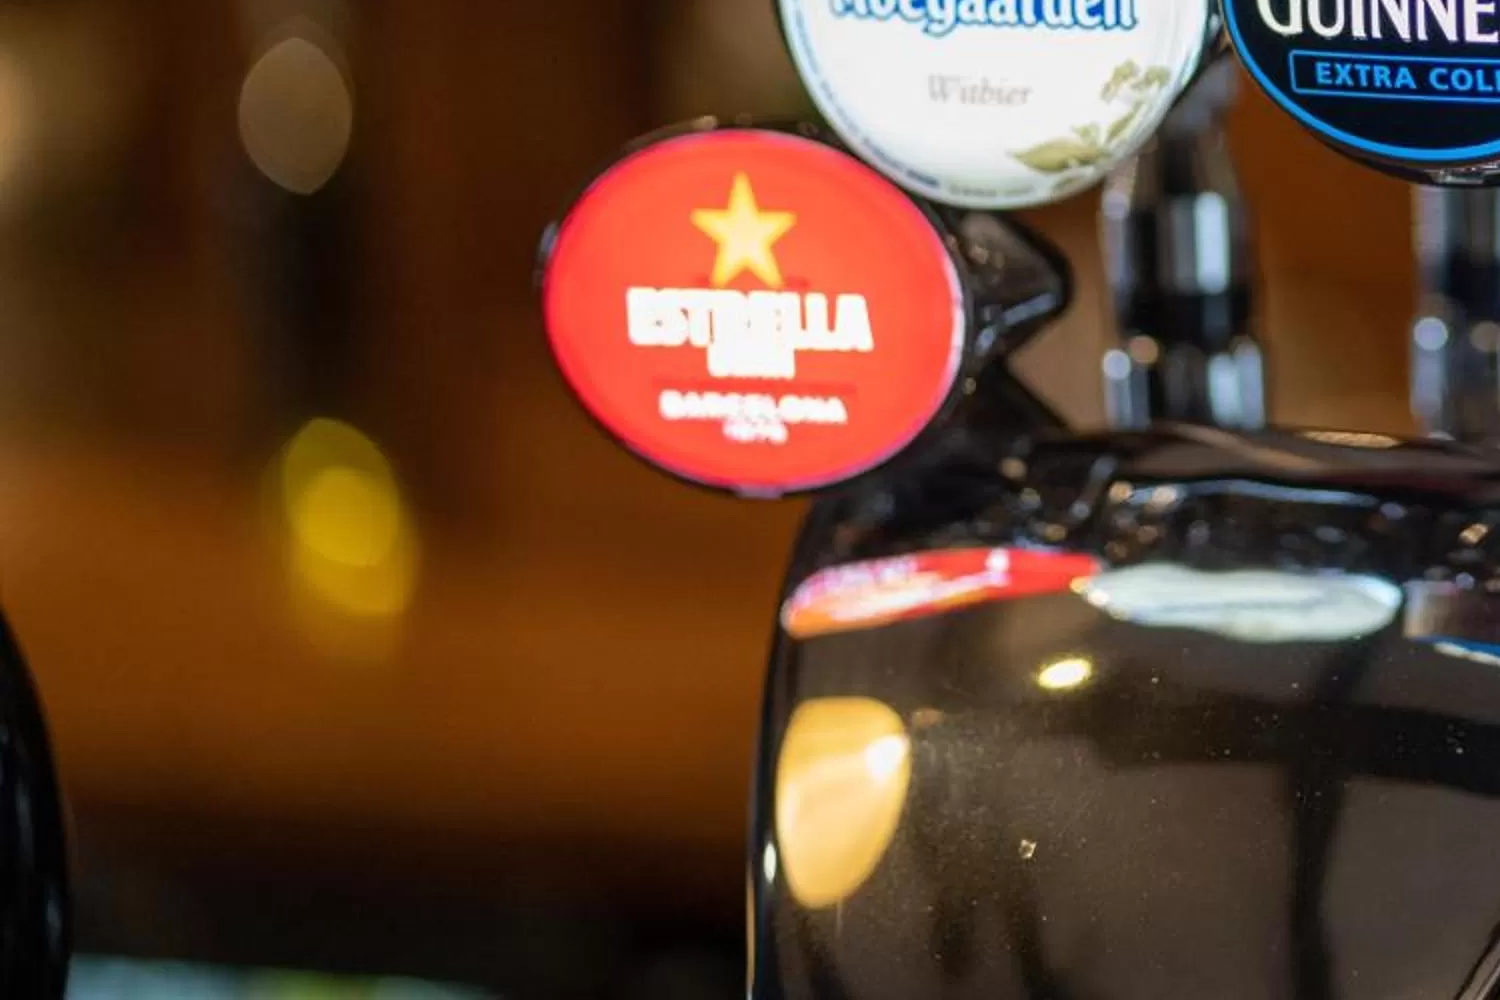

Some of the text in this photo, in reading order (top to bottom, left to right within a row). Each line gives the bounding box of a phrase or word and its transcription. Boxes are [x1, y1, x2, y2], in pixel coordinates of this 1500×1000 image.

[928, 72, 1034, 106] Witbier
[1315, 62, 1418, 91] EXTRA
[626, 287, 874, 352] ESTRELLA
